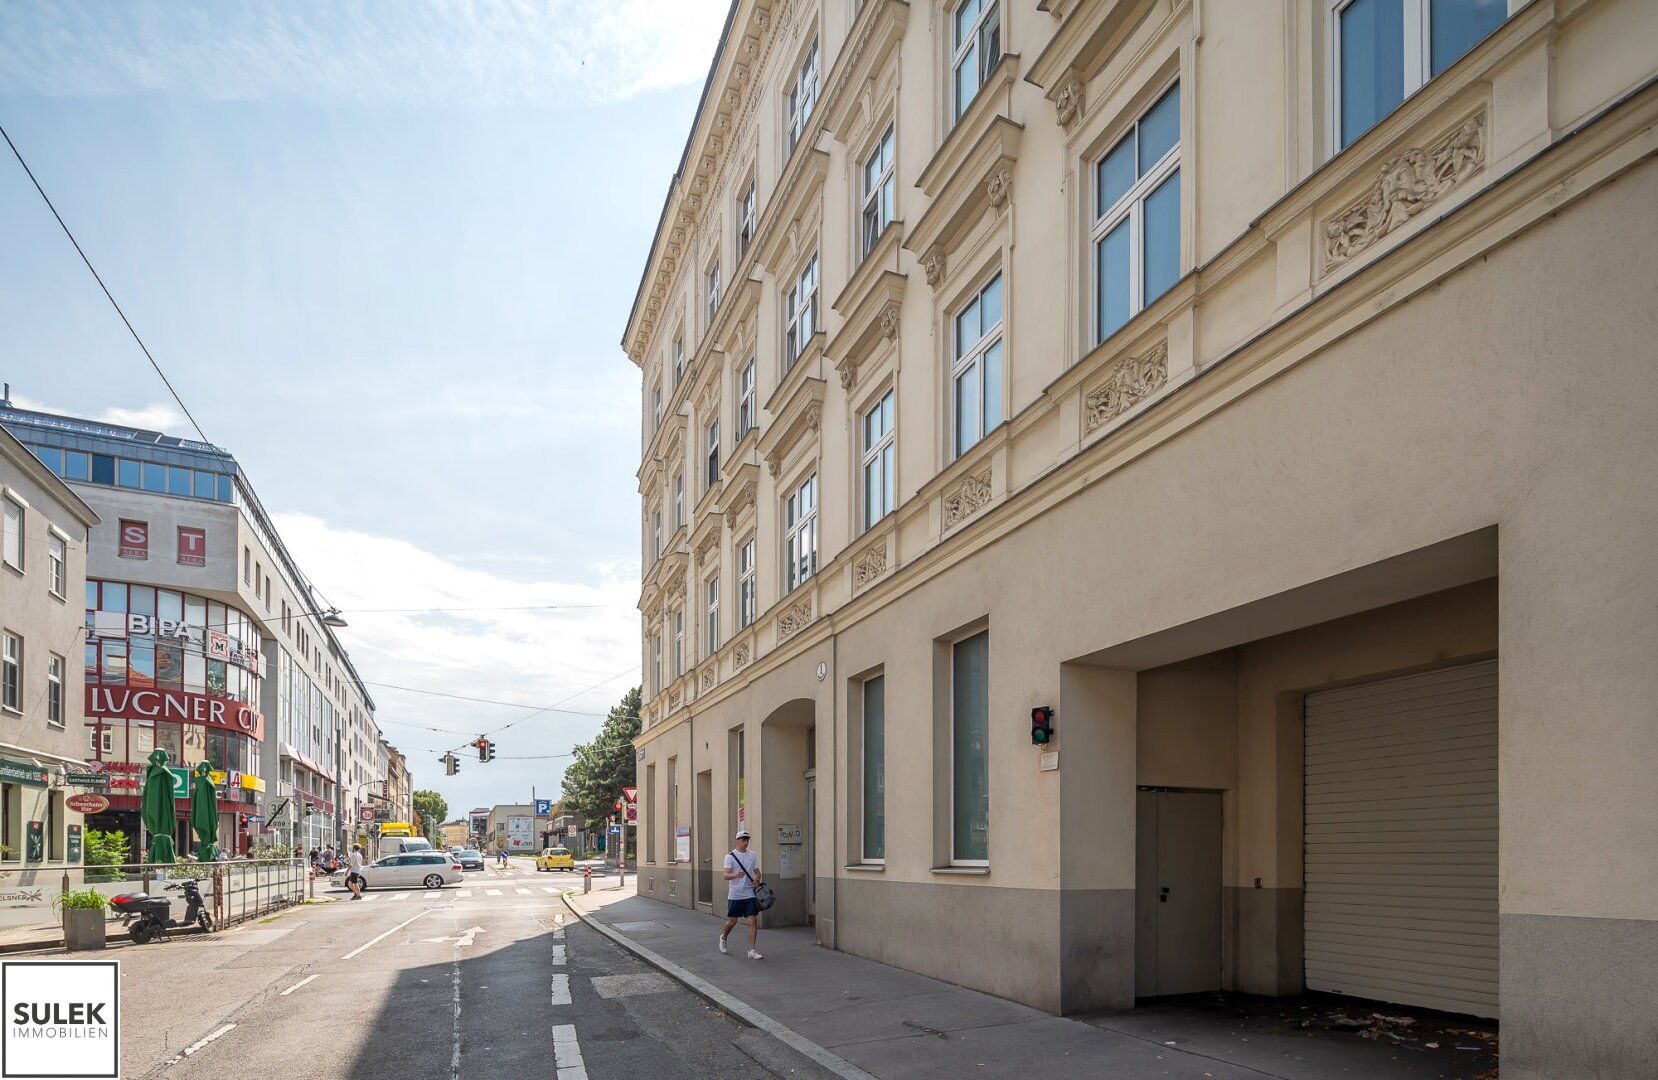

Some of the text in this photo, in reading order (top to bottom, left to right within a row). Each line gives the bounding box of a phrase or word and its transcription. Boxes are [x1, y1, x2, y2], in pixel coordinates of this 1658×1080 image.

[124, 526, 146, 544] S
[181, 532, 203, 551] T
[128, 613, 191, 639] BIPA
[91, 687, 226, 725] LUGNER
